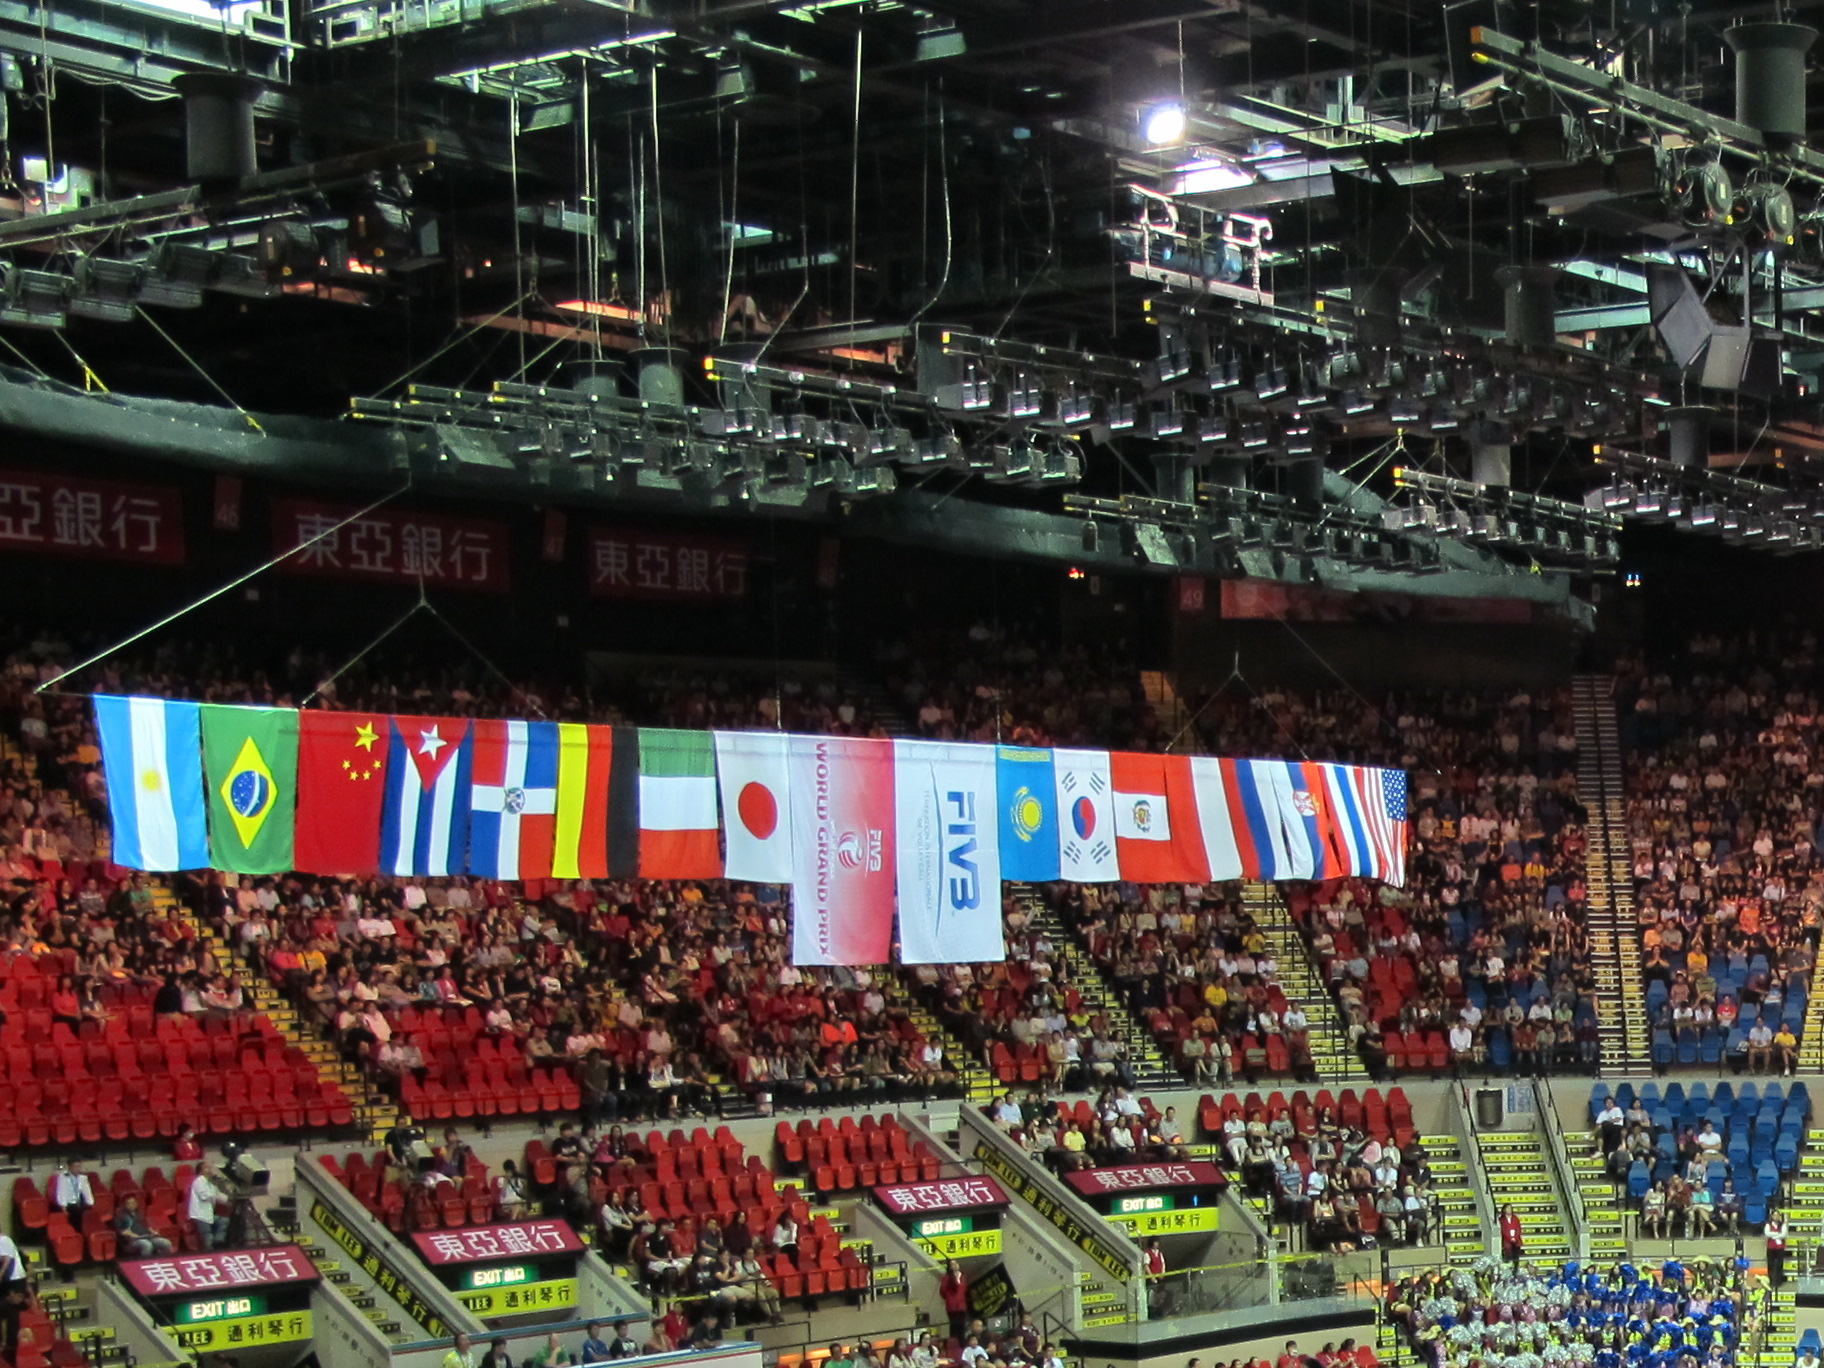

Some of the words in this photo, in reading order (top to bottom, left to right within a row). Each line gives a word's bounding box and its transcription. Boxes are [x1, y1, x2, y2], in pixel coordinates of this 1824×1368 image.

[294, 513, 491, 582] 東亞銀行
[594, 542, 749, 595] 東亞銀行
[815, 741, 831, 821] WORLD
[816, 826, 831, 904] GRAND
[868, 829, 884, 873] FIVB
[946, 790, 982, 911] FIVB
[816, 904, 832, 955] PRIX
[887, 1180, 995, 1210] 東亞銀行
[1092, 1165, 1197, 1189] 東亞銀行
[1121, 1198, 1143, 1211] EXIT
[429, 1224, 566, 1261] 東亞銀行
[921, 1221, 944, 1235] EXIT
[140, 1249, 299, 1292] 東亞銀行
[473, 1270, 502, 1287] EXIT
[190, 1300, 225, 1319] EXIT
[468, 1297, 489, 1311] LEE
